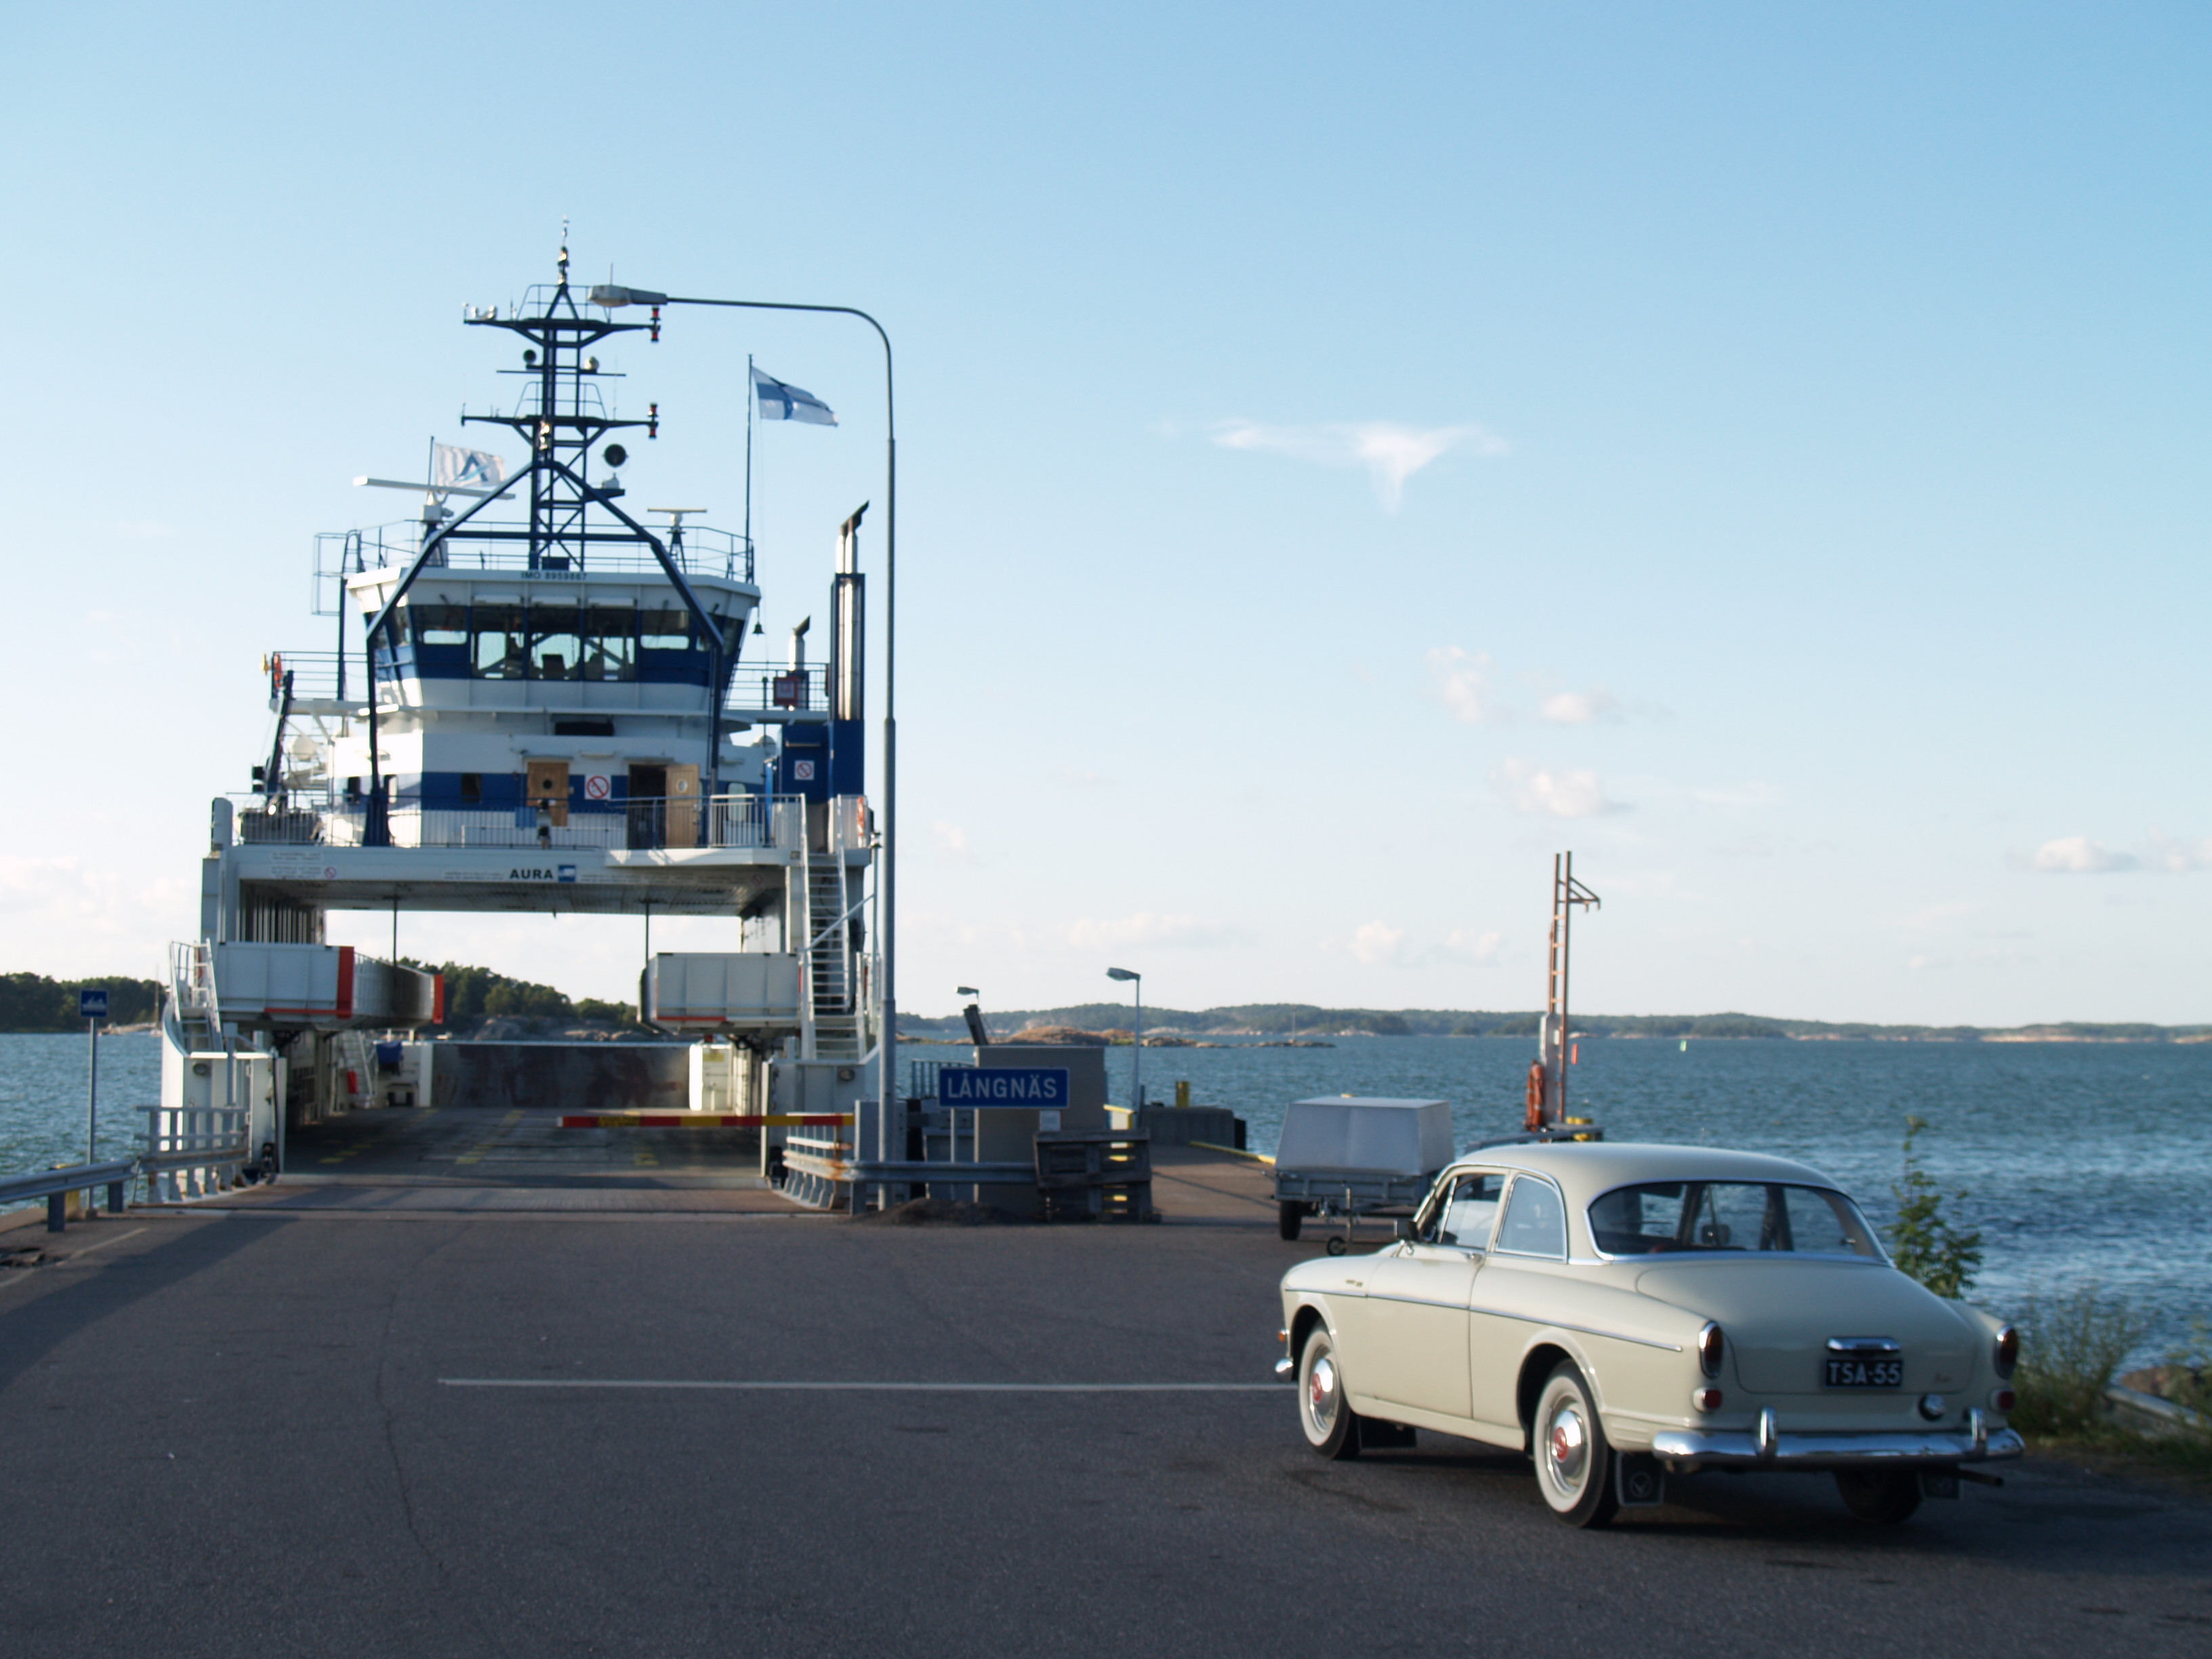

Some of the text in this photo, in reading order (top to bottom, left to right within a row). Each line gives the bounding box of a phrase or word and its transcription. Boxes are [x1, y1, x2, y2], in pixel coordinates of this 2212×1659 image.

[520, 571, 541, 579] IMO
[510, 869, 554, 880] AURA
[947, 1072, 1058, 1099] LÅNGNÄS
[1828, 1362, 1900, 1385] TSA-55
